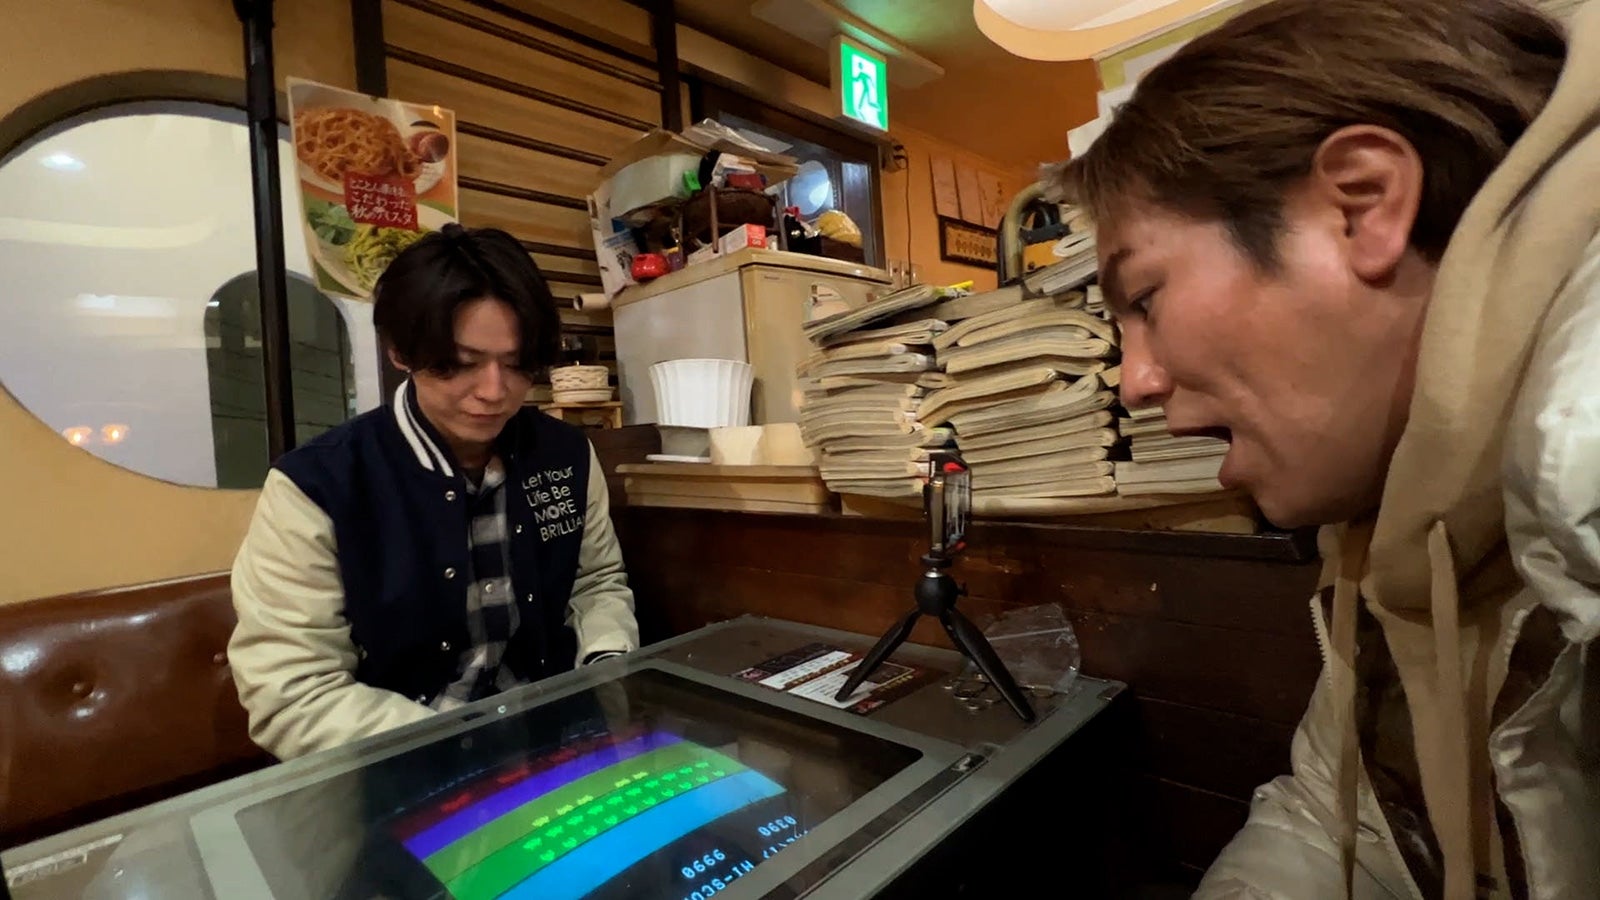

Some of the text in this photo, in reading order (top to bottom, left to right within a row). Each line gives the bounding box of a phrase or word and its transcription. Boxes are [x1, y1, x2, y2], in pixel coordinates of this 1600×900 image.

[522, 466, 573, 490] Let Your
[526, 485, 571, 507] Life Be
[534, 499, 577, 524] MORE
[681, 815, 797, 880] 0390 9990
[684, 860, 755, 900] HI-SCO
